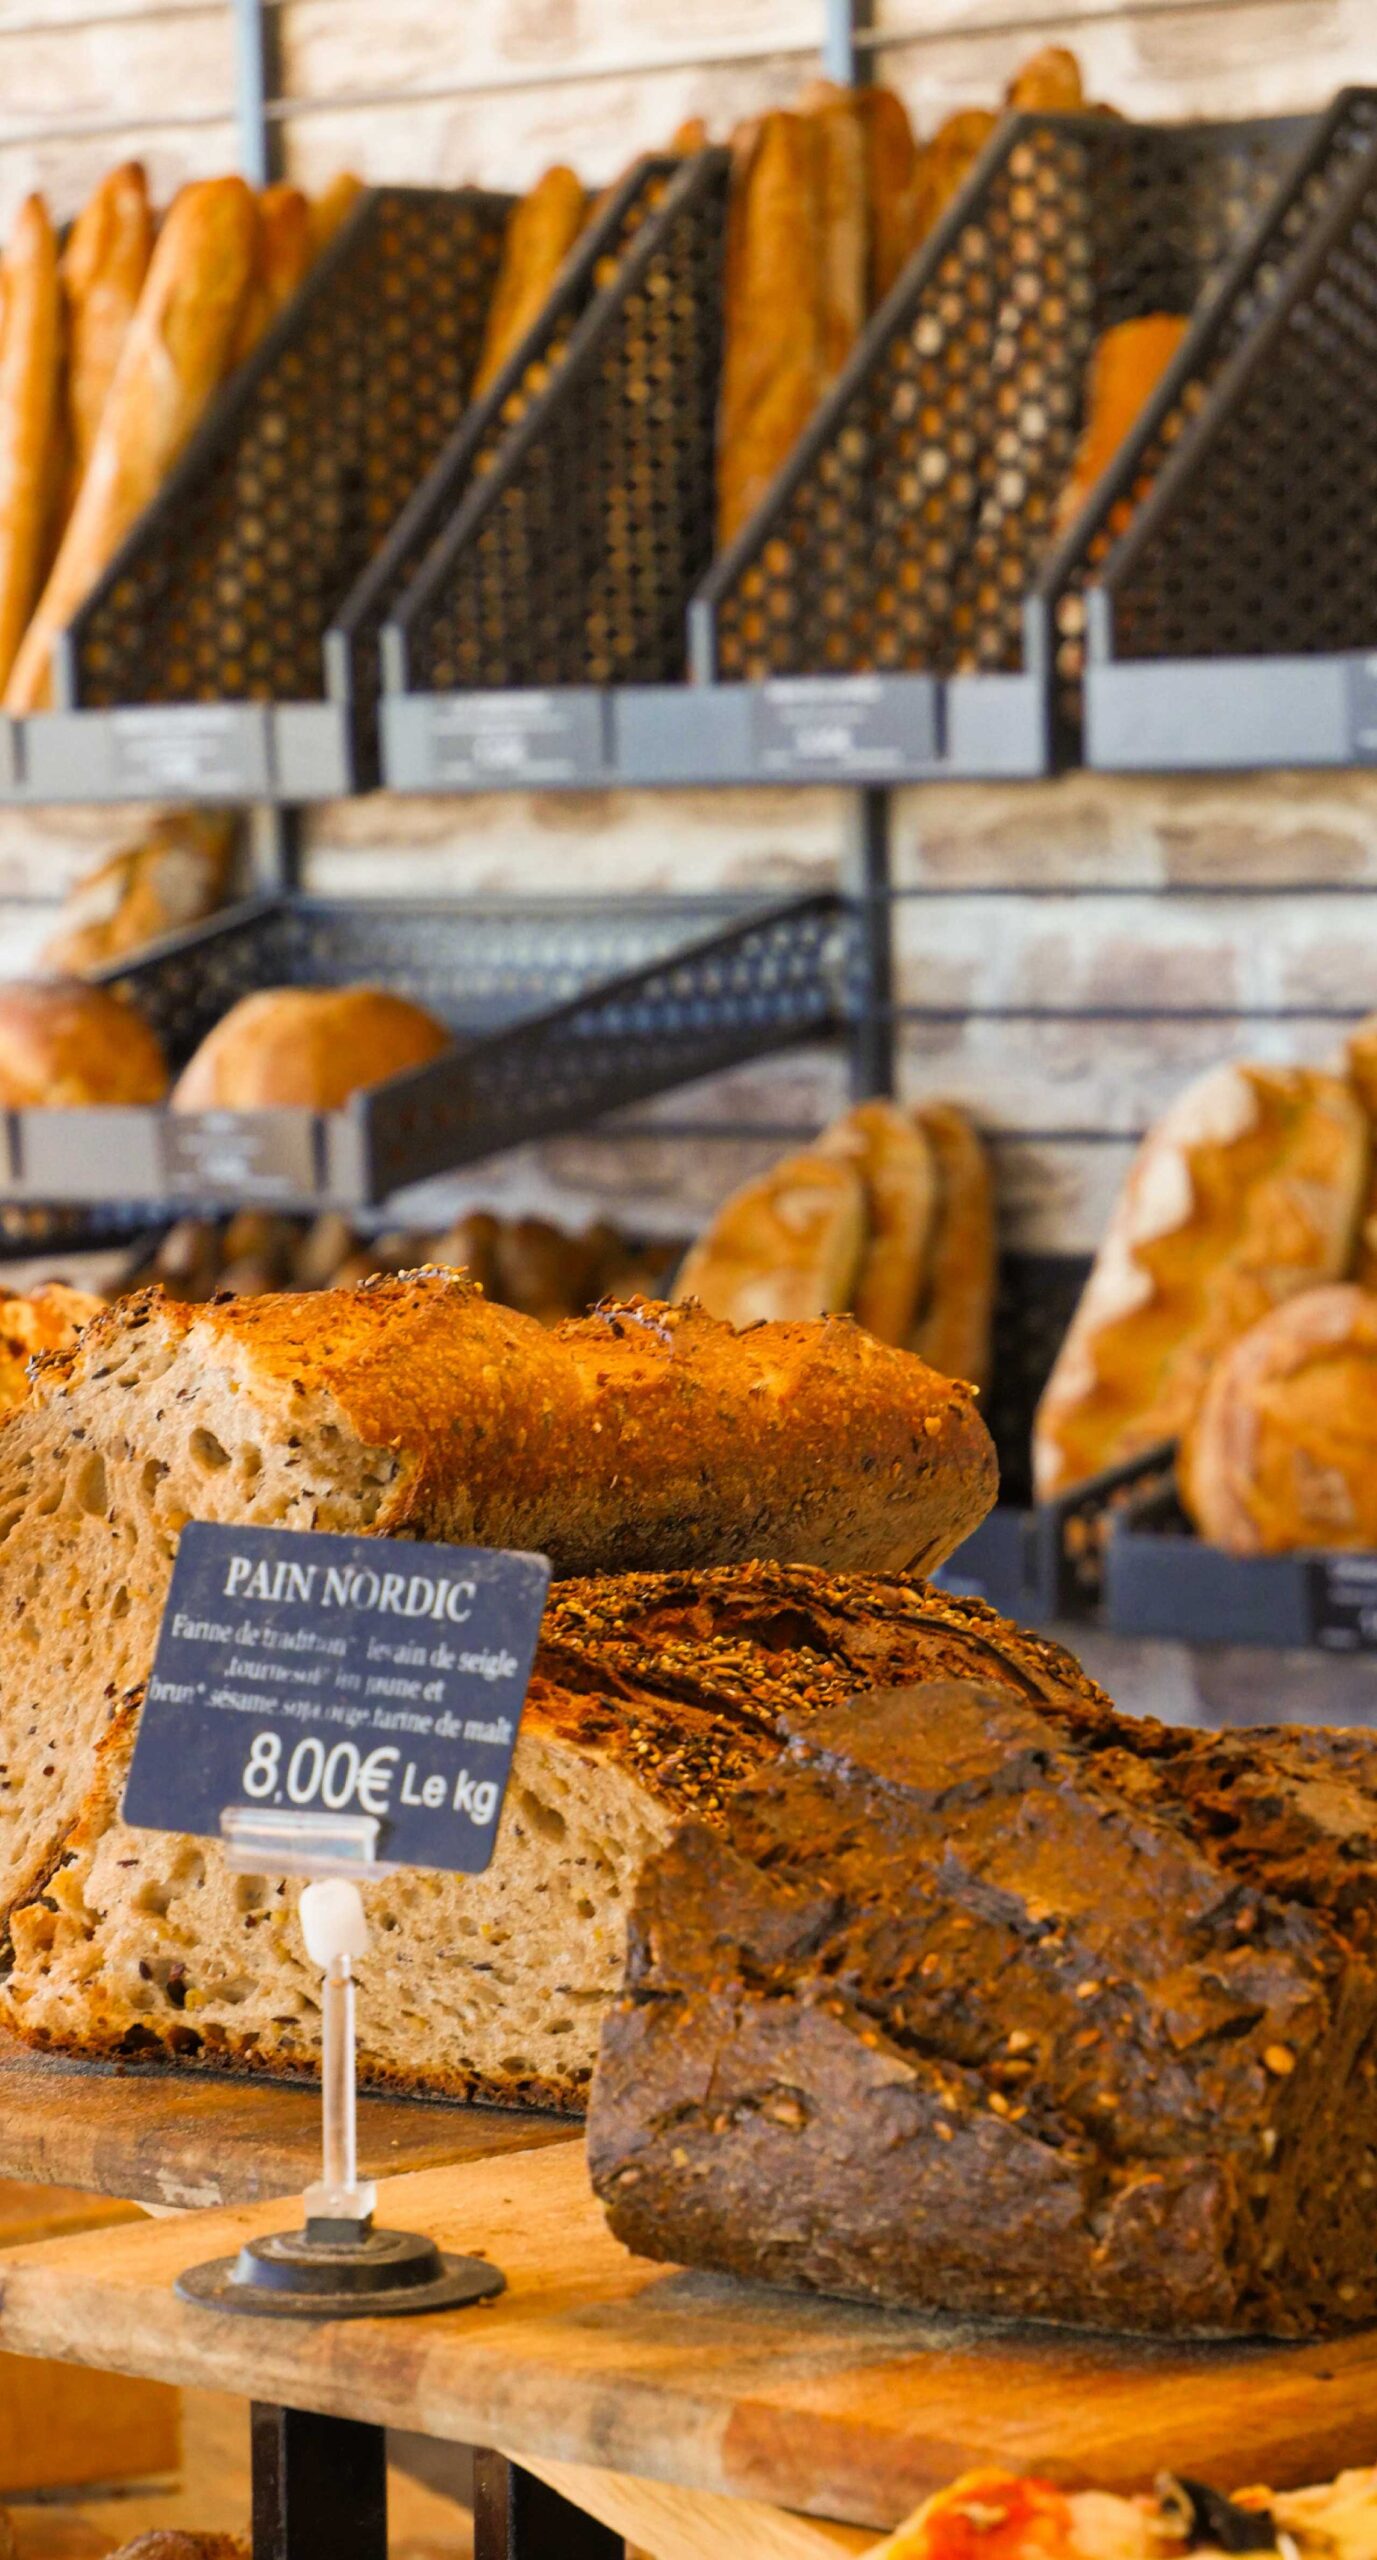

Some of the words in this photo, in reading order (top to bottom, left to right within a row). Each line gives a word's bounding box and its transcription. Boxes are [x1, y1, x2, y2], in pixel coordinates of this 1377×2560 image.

[224, 1556, 317, 1602] PAIN
[321, 1567, 476, 1622] NORDIC
[171, 1613, 233, 1643] Farine
[235, 1620, 259, 1646] de
[430, 1642, 457, 1670] de
[458, 1647, 518, 1681] seigle
[423, 1679, 446, 1702] et
[434, 1710, 462, 1738] de
[463, 1716, 513, 1745] malt
[400, 1762, 447, 1808] Le
[453, 1769, 499, 1825] kg
